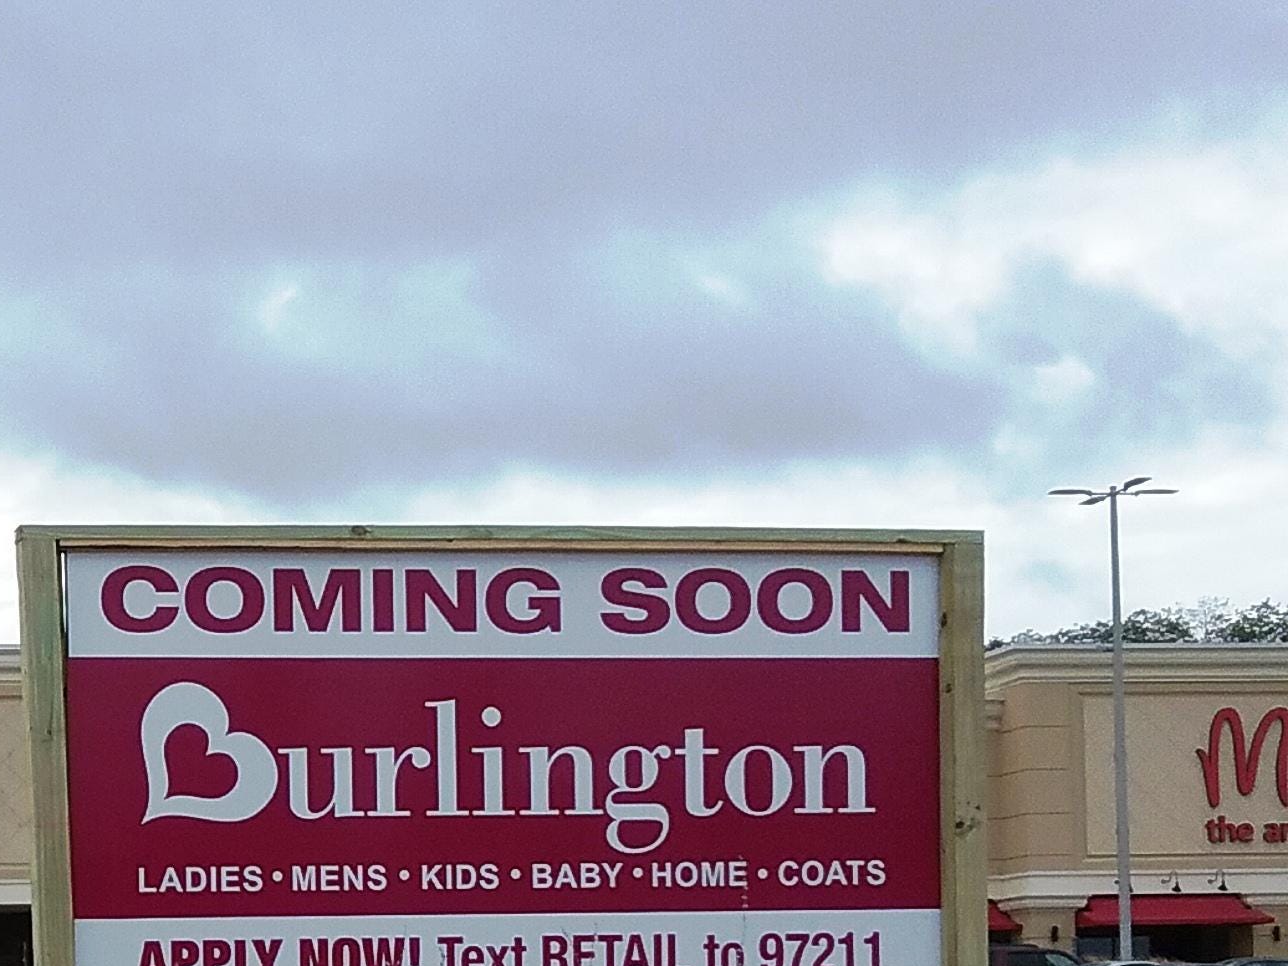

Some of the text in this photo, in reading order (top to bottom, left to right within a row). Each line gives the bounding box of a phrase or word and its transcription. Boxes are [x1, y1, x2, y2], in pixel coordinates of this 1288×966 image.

[100, 565, 910, 635] COMING SOON
[140, 681, 876, 854] Burlington
[1205, 815, 1255, 843] the
[138, 860, 886, 893] LADIES MENS KIDS BABY HOME COATS
